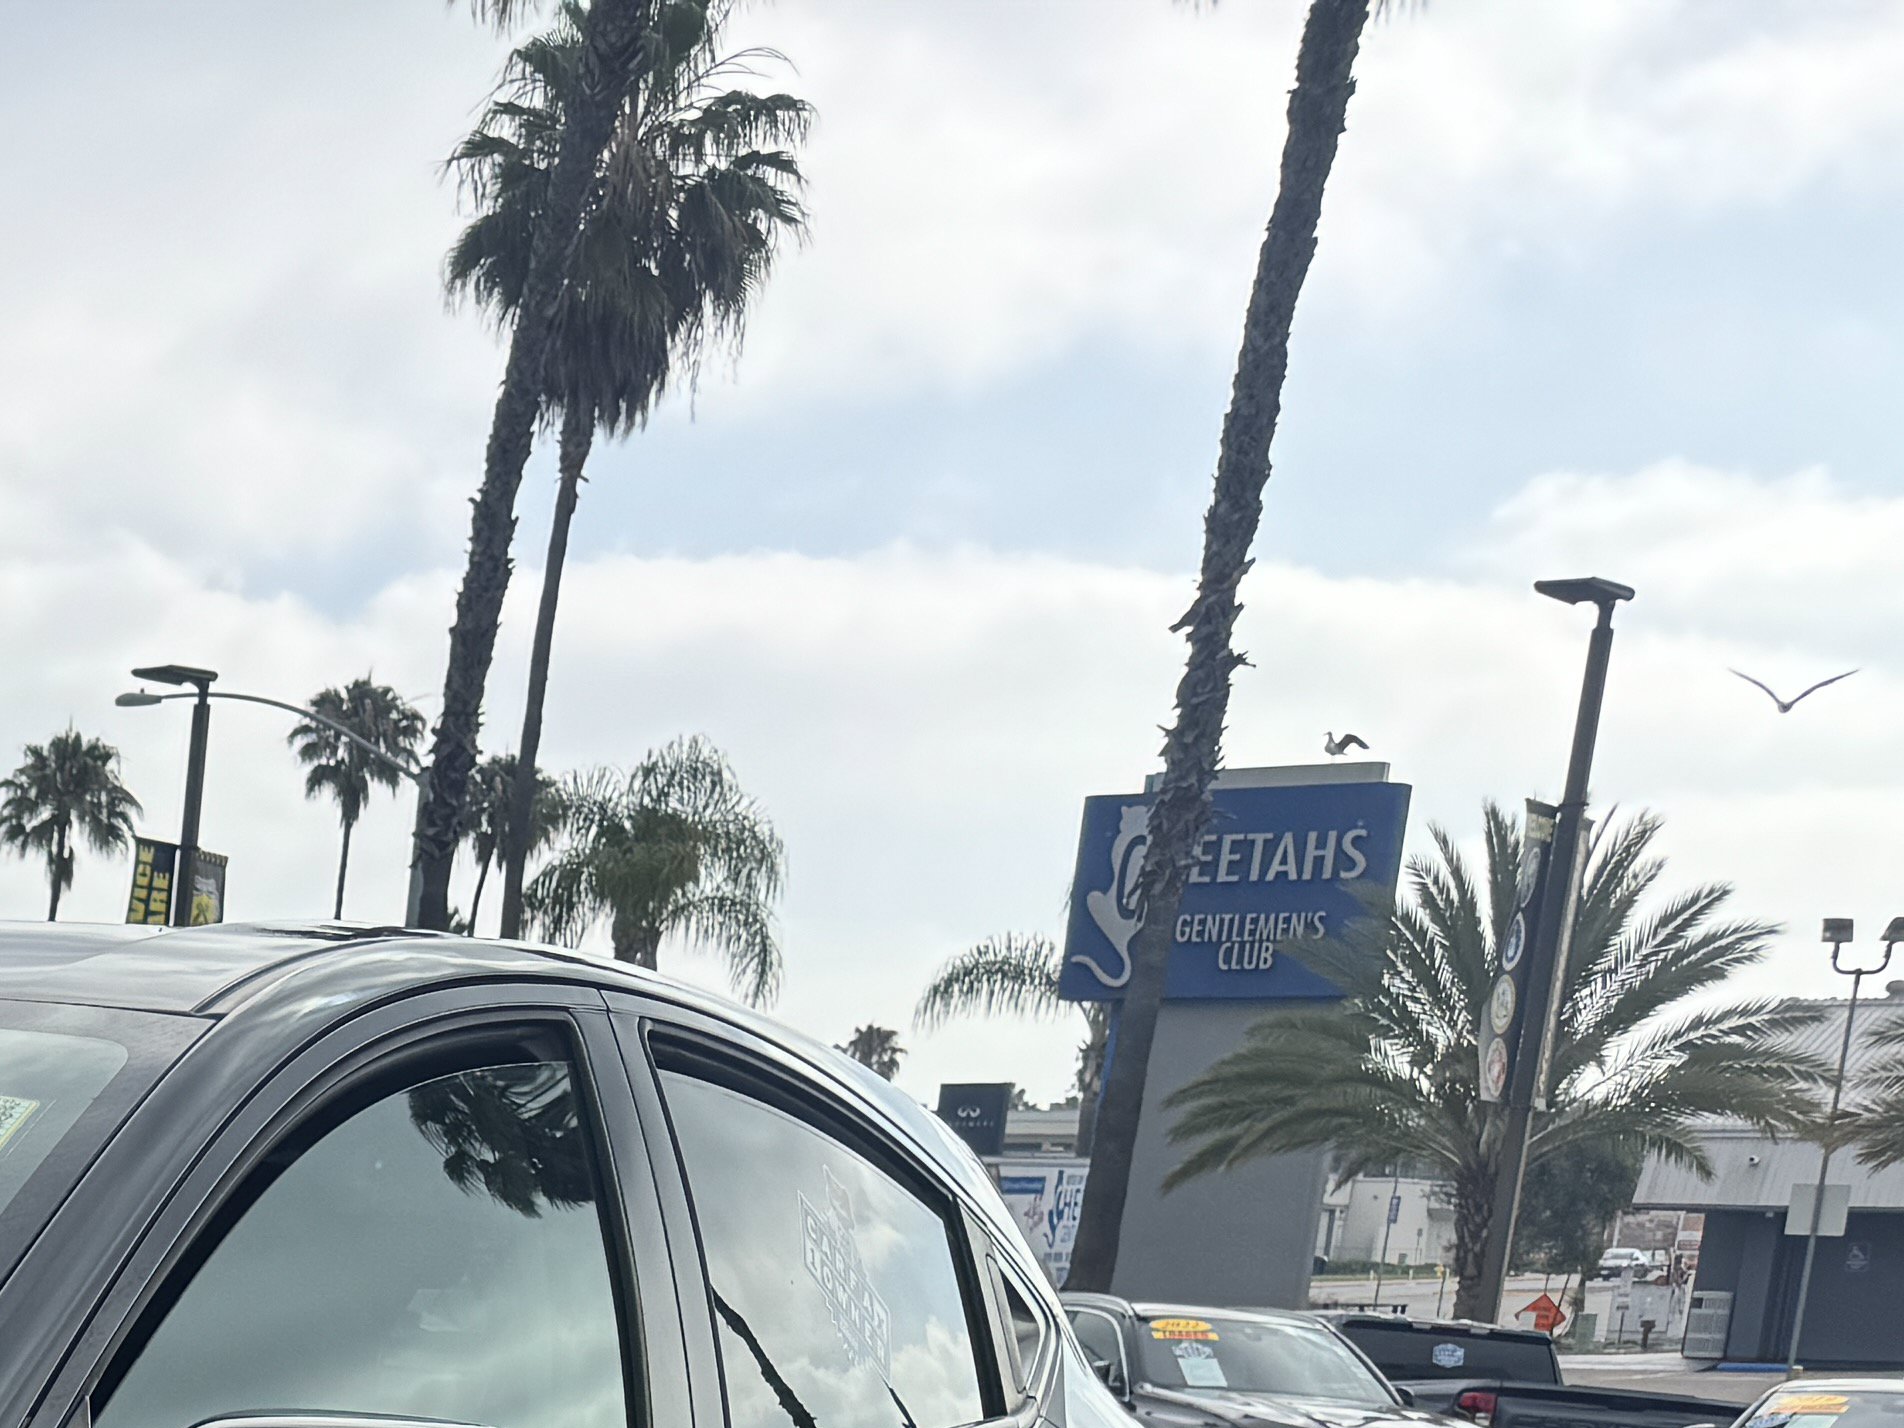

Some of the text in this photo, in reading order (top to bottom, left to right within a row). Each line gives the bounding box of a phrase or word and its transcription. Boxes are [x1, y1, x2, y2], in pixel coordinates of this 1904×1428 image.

[127, 844, 155, 923] VICE
[1175, 910, 1327, 943] GENTLEMEN'S
[1217, 942, 1274, 971] CLUB
